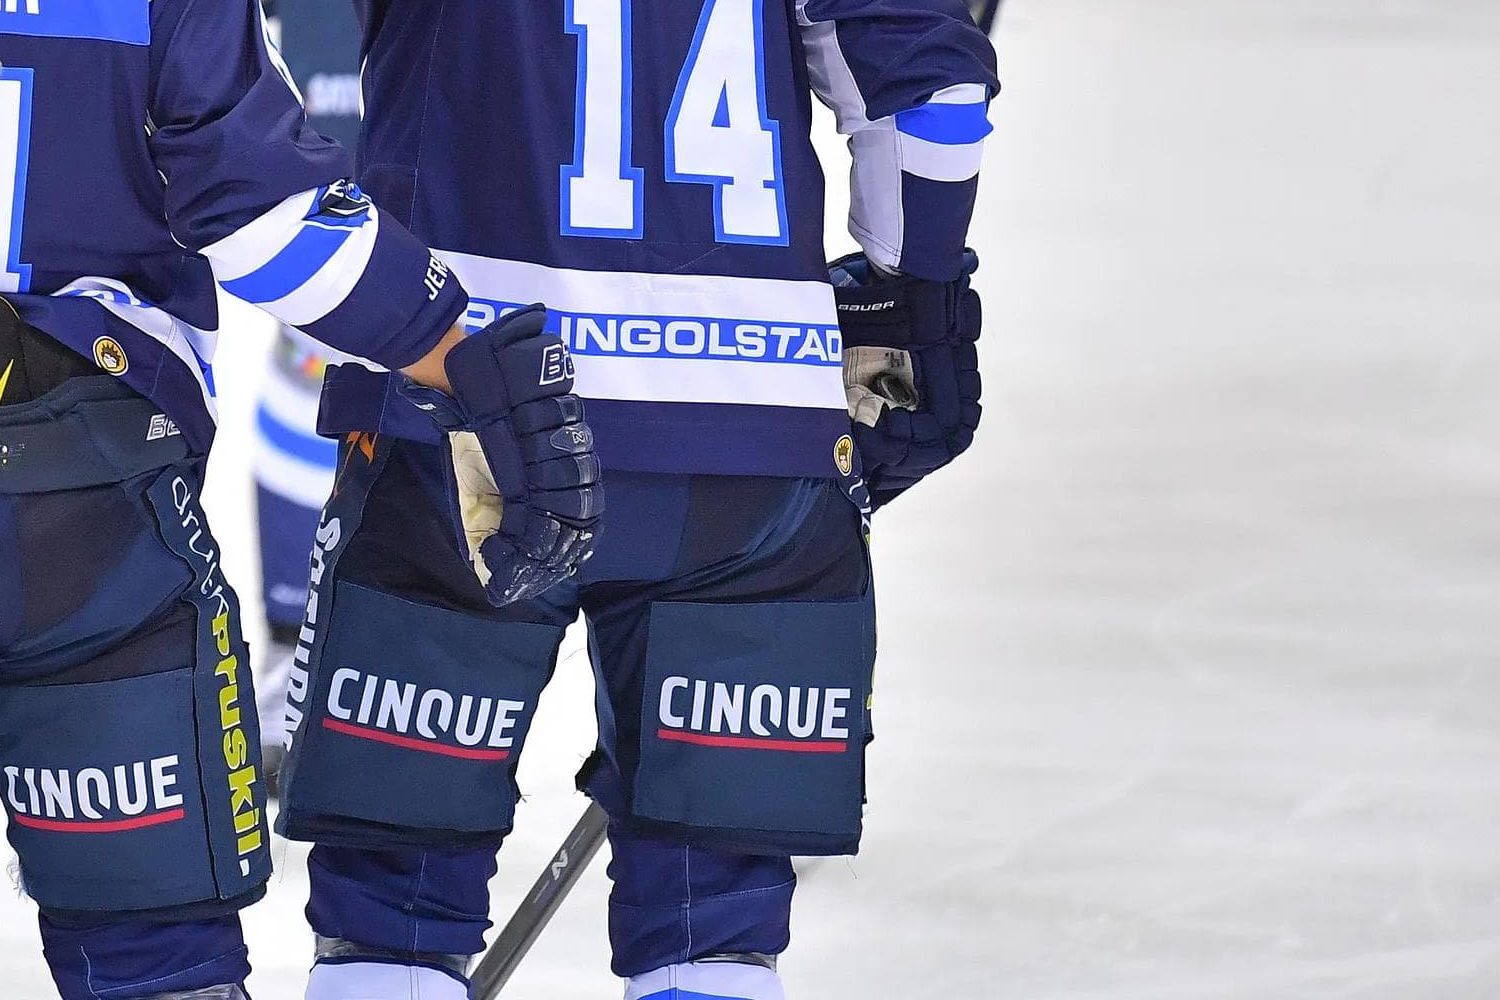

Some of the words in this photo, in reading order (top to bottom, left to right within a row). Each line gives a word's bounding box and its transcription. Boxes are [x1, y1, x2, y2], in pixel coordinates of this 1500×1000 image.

[837, 299, 895, 312] BAUER
[328, 667, 524, 748] CINQUE
[658, 675, 851, 740] CINQUE
[7, 755, 184, 821] CINQUE
